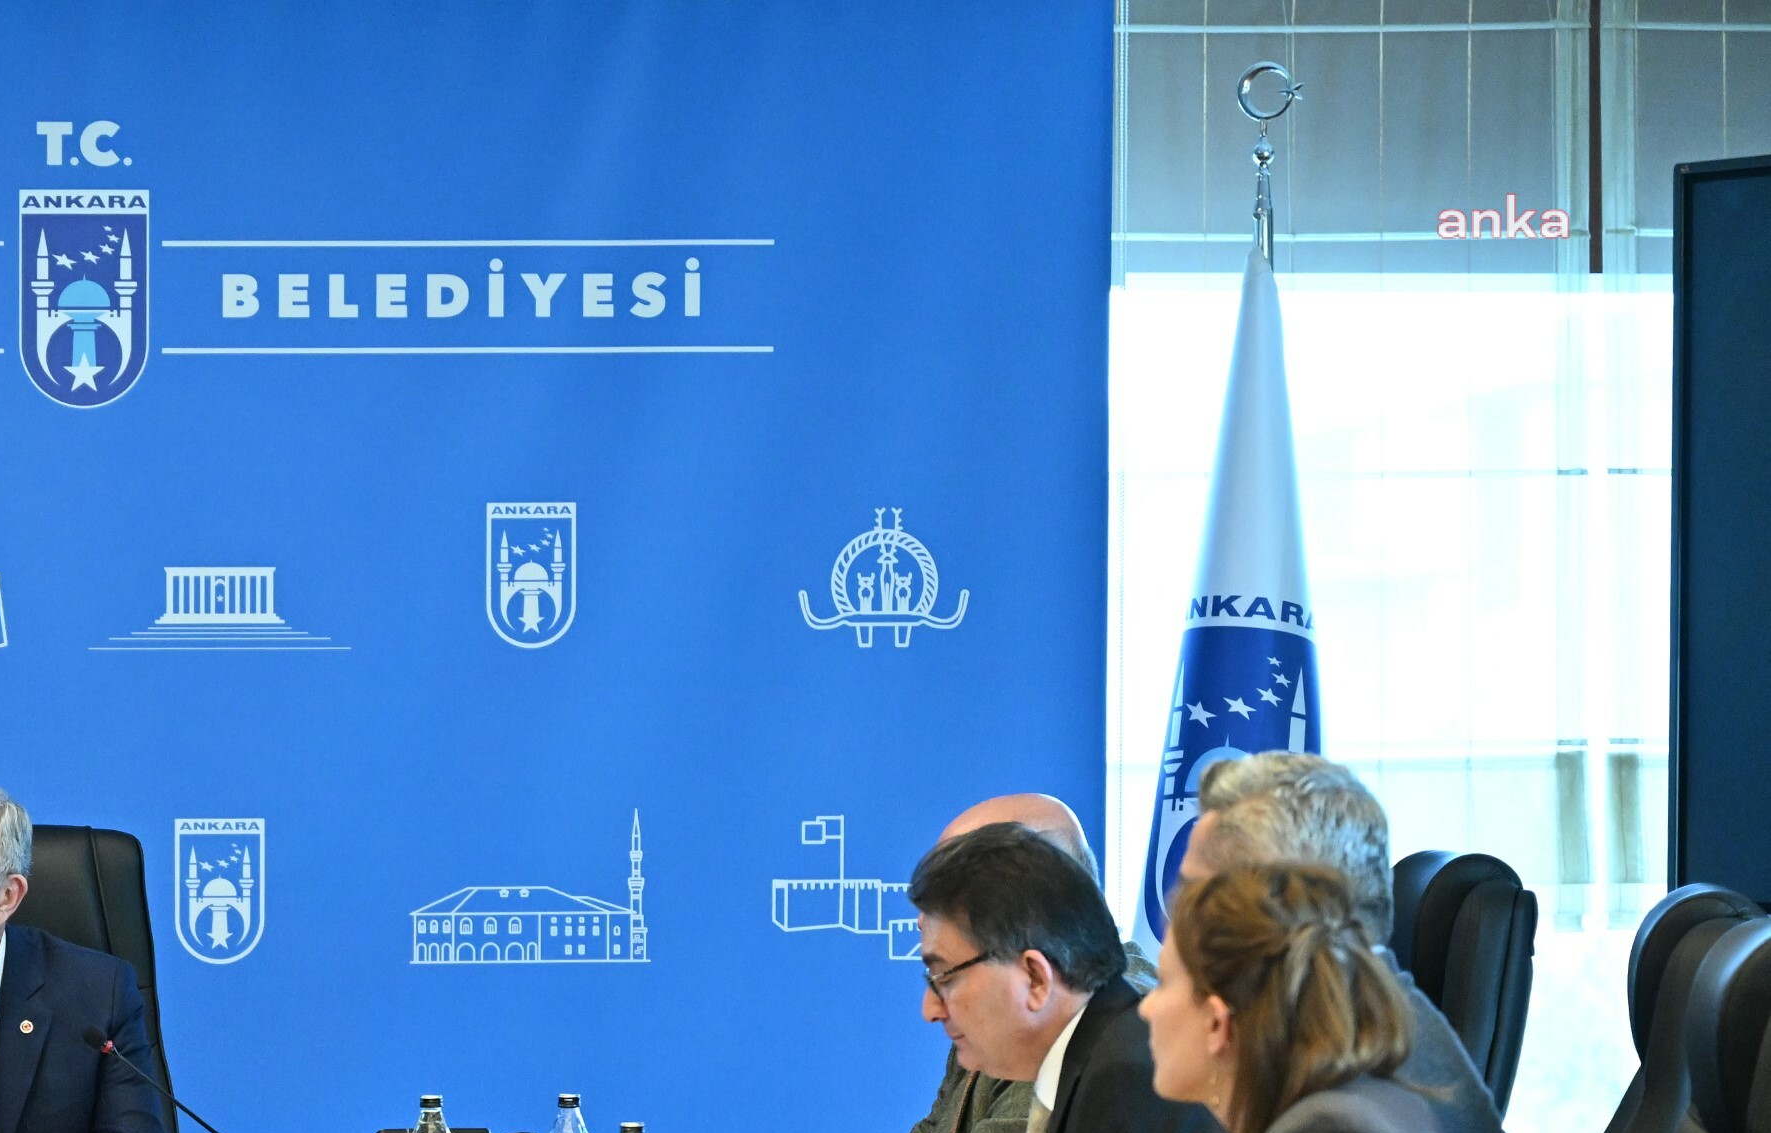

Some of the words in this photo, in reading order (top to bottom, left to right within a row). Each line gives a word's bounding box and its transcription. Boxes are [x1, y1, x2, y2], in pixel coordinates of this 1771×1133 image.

[36, 119, 133, 167] T.C.
[22, 195, 147, 209] ANKARA
[221, 256, 701, 319] BELEDİYESİ
[491, 505, 573, 515] ANKARA
[179, 821, 261, 831] ANKARA
